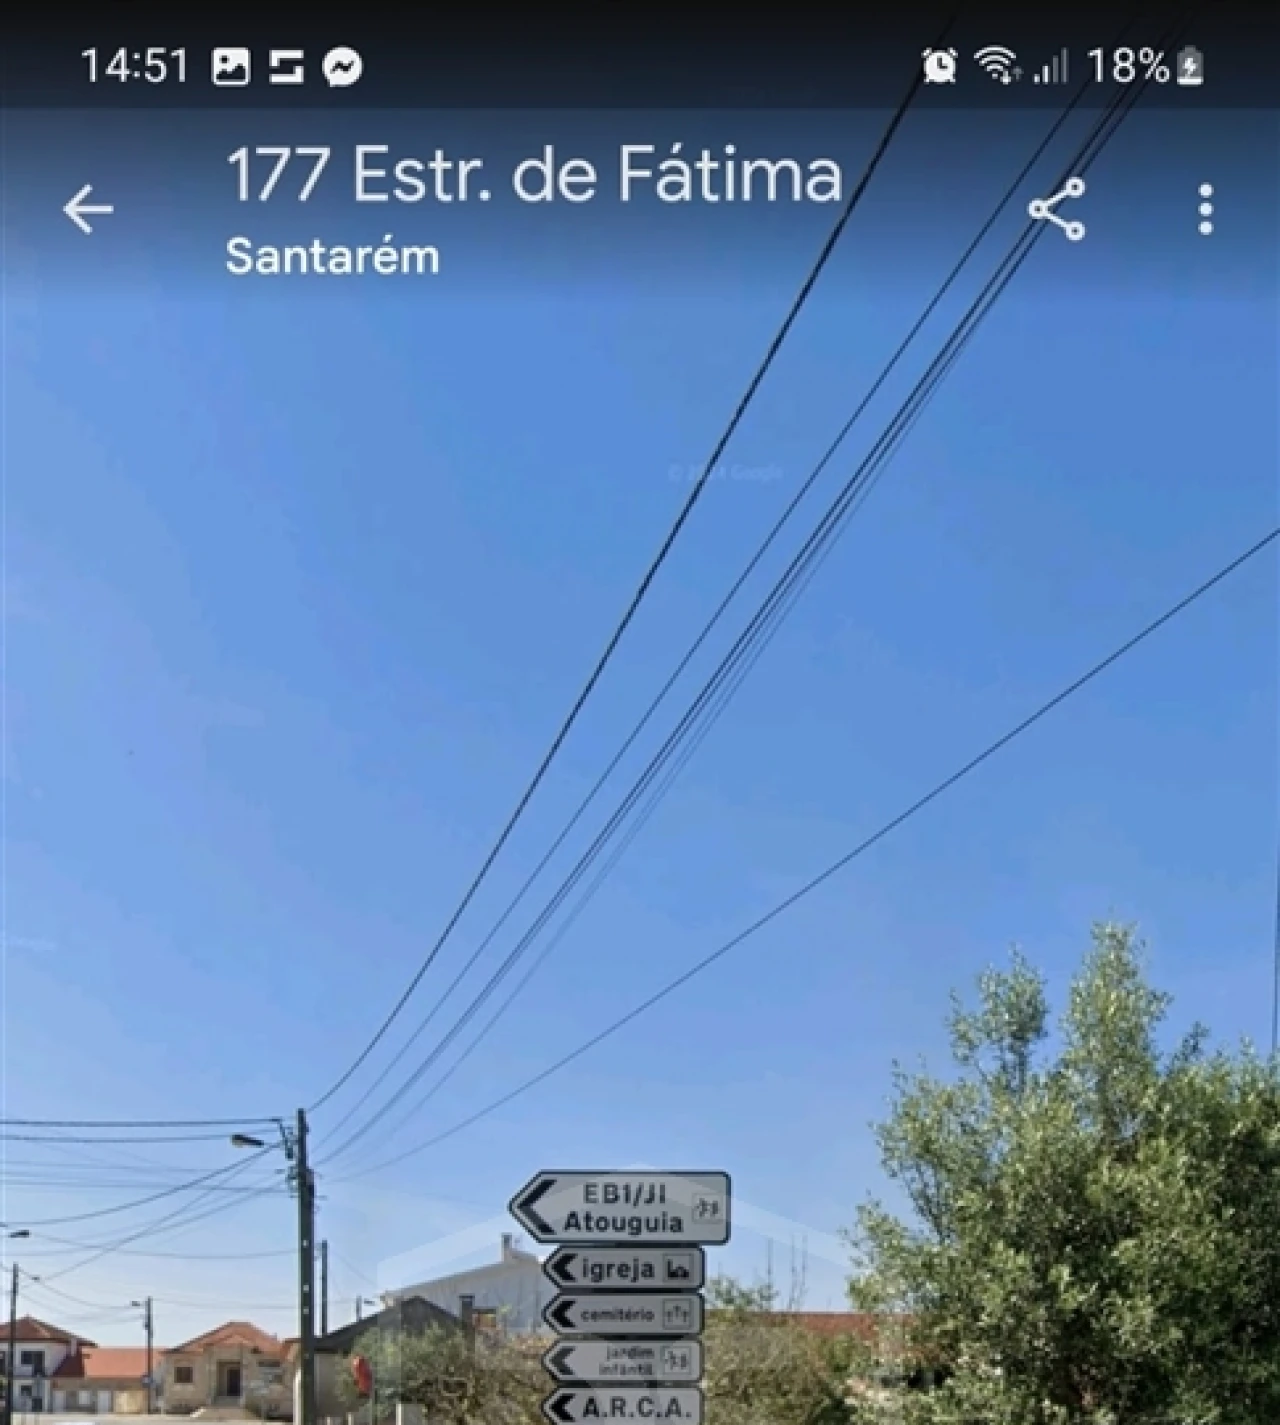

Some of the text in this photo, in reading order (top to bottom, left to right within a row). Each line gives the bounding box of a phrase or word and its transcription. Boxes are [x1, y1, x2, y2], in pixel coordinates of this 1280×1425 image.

[81, 47, 187, 82] 14:51
[1087, 46, 1170, 83] 18%
[227, 142, 843, 203] 177 Estr. de Fátima
[225, 233, 440, 274] Santarém
[584, 1182, 666, 1206] EB1/JI
[564, 1210, 684, 1236] Atouguia
[583, 1258, 655, 1283] igreja
[580, 1308, 655, 1322] cemitério
[582, 1396, 692, 1418] A.R.C.A.
